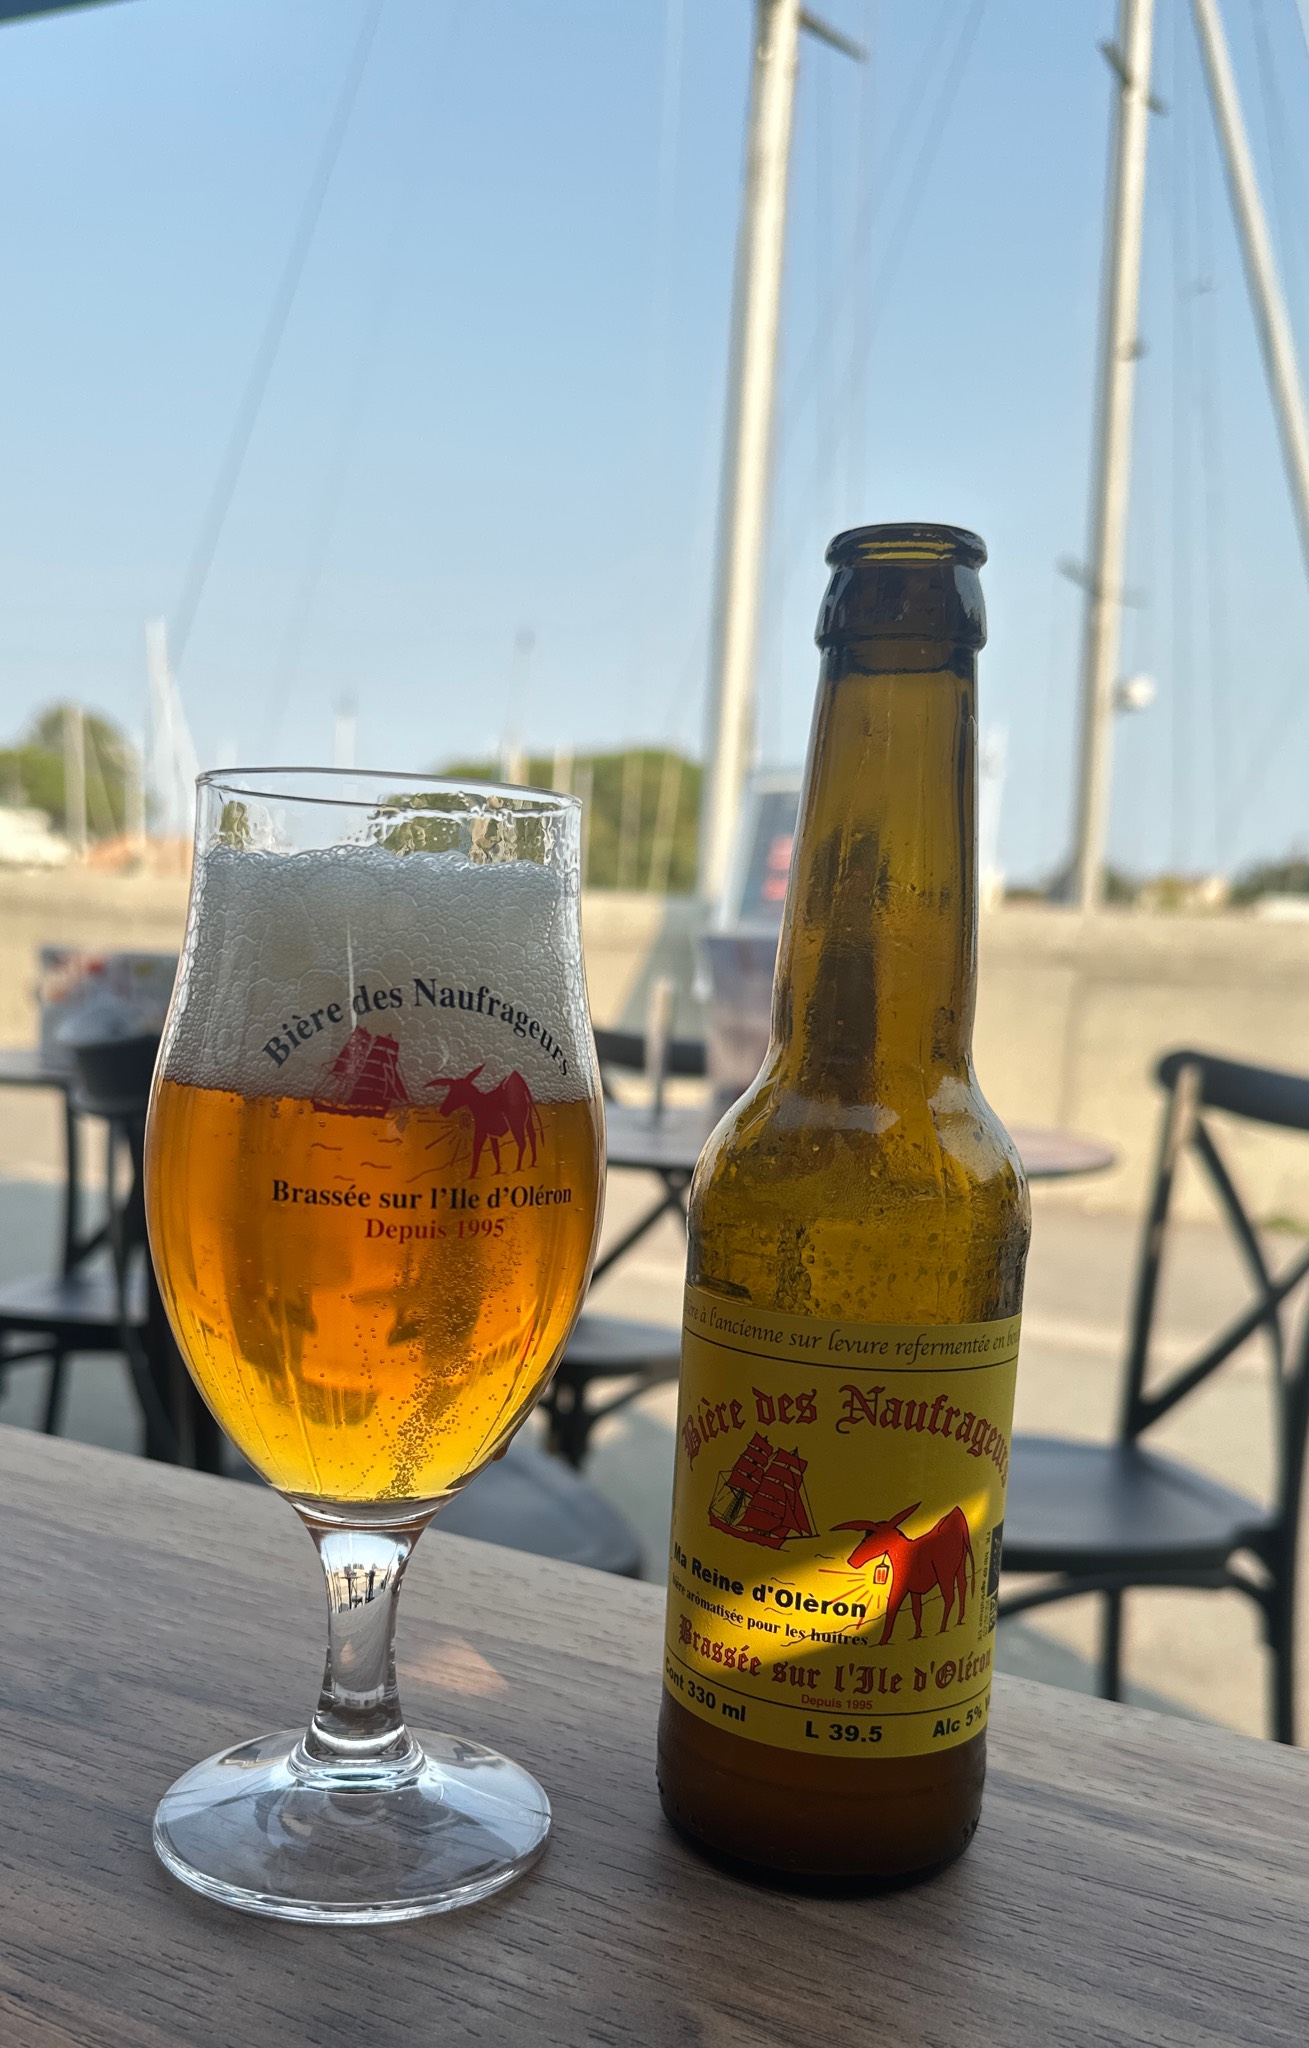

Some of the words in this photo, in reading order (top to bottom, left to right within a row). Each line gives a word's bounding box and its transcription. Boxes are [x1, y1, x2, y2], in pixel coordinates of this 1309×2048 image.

[262, 1001, 344, 1068] Bière
[353, 985, 404, 1015] des
[413, 978, 569, 1076] Naufrageurs
[271, 1179, 371, 1208] Brassée
[379, 1192, 422, 1210] sur
[365, 1218, 447, 1244] Depuis
[457, 1218, 506, 1240] 1995
[700, 1305, 707, 1325] à
[709, 1306, 783, 1344] l'ancienne
[789, 1330, 822, 1349] sur
[828, 1329, 889, 1355] levure
[895, 1334, 990, 1365] refermentée
[992, 1338, 1005, 1350] en
[682, 1397, 746, 1472] Bière
[751, 1386, 818, 1425] des
[674, 1542, 687, 1569] Ma
[691, 1557, 744, 1596] Reine
[752, 1583, 867, 1618] d'Olèron
[747, 1617, 782, 1634] pour
[785, 1623, 806, 1639] les
[678, 1613, 762, 1677] Brassée
[771, 1660, 822, 1690] sur
[912, 1647, 991, 1693] d'Oléron
[665, 1656, 684, 1691] Cont
[687, 1680, 716, 1710] 330
[721, 1702, 746, 1723] ml
[801, 1693, 842, 1709] Depuis
[846, 1699, 873, 1710] 1995
[805, 1720, 819, 1739] L
[828, 1723, 883, 1743] 39.5
[932, 1717, 960, 1738] Alc
[965, 1703, 982, 1727] 5%
